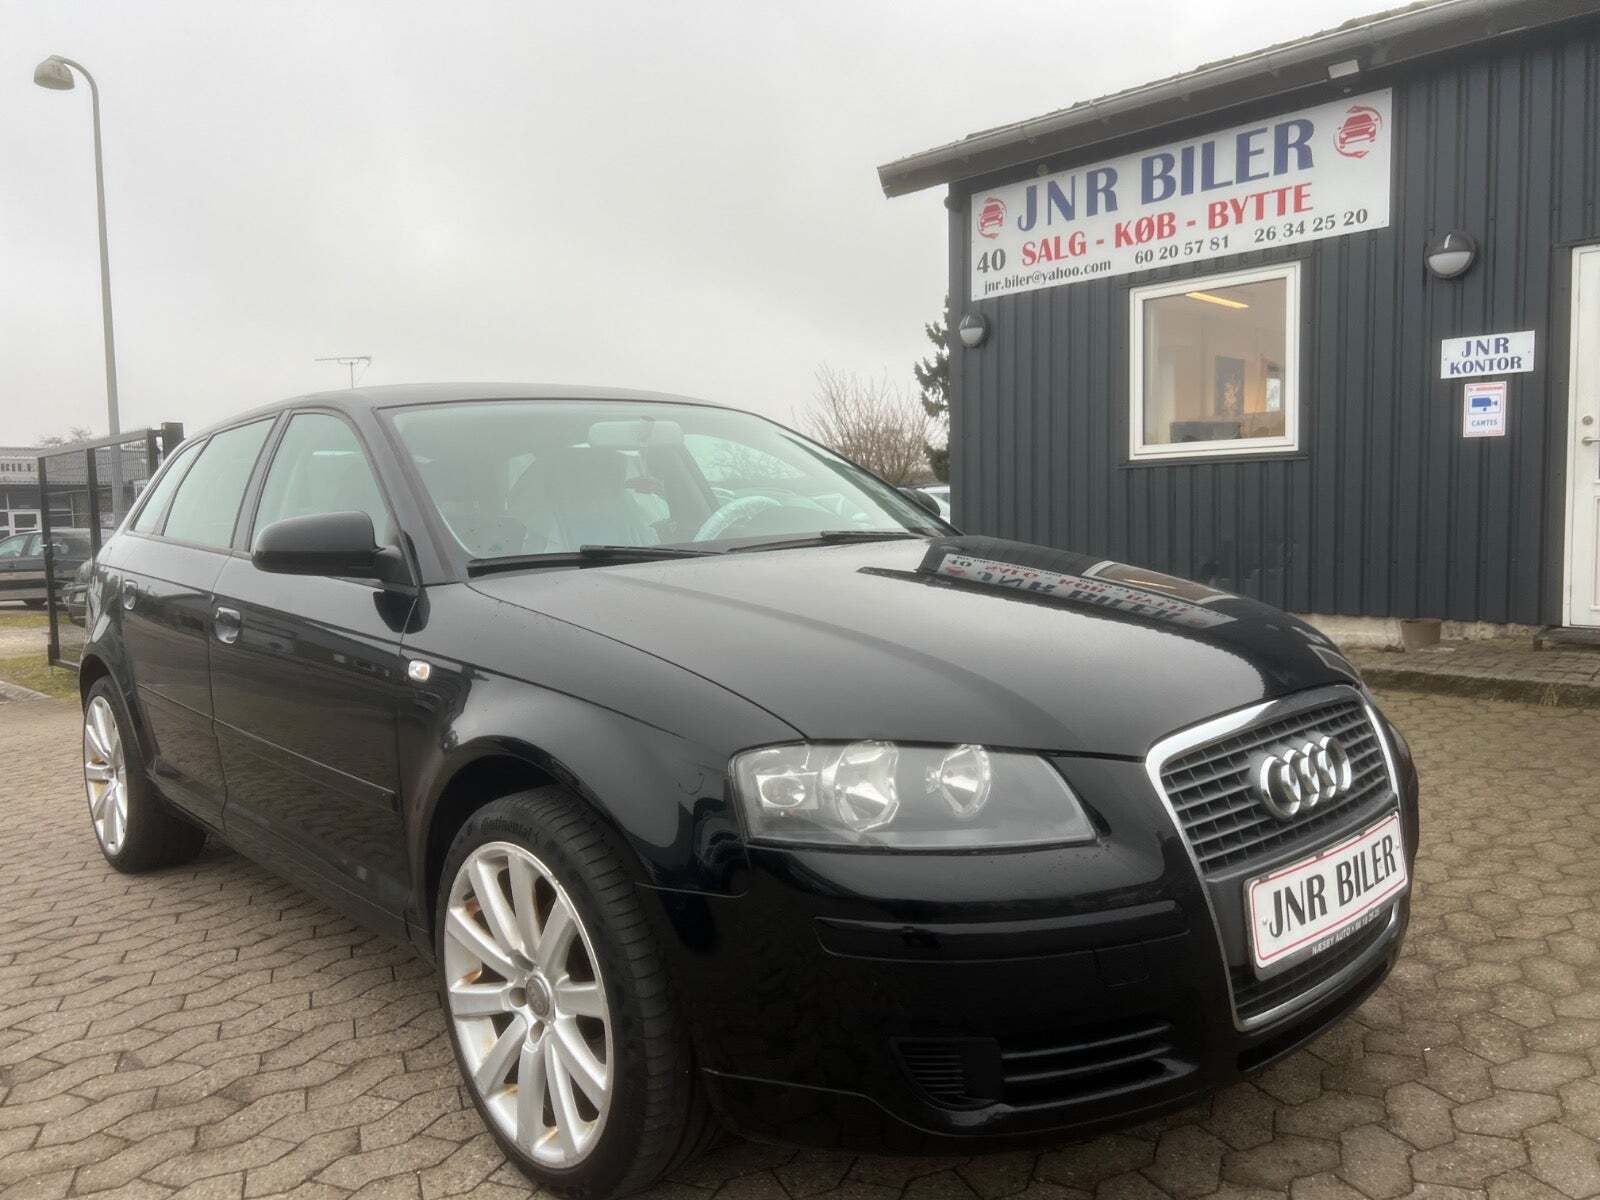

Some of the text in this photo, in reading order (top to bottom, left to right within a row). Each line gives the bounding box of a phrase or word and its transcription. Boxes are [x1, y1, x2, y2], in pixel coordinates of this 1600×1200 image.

[1017, 118, 1315, 232] JNR BILER
[1022, 231, 1087, 266] SALG
[1115, 211, 1176, 249] KØB
[1208, 182, 1313, 231] BYTTE
[1254, 208, 1368, 243] 26 34 25 20
[976, 248, 1006, 274] 40
[1135, 235, 1230, 265] 60 20 57 81
[984, 259, 1111, 295] jnr.biler@yahoo.com
[1462, 336, 1510, 358] JNR
[1449, 356, 1522, 375] KONTOR
[1269, 834, 1397, 938] JNR BILER
